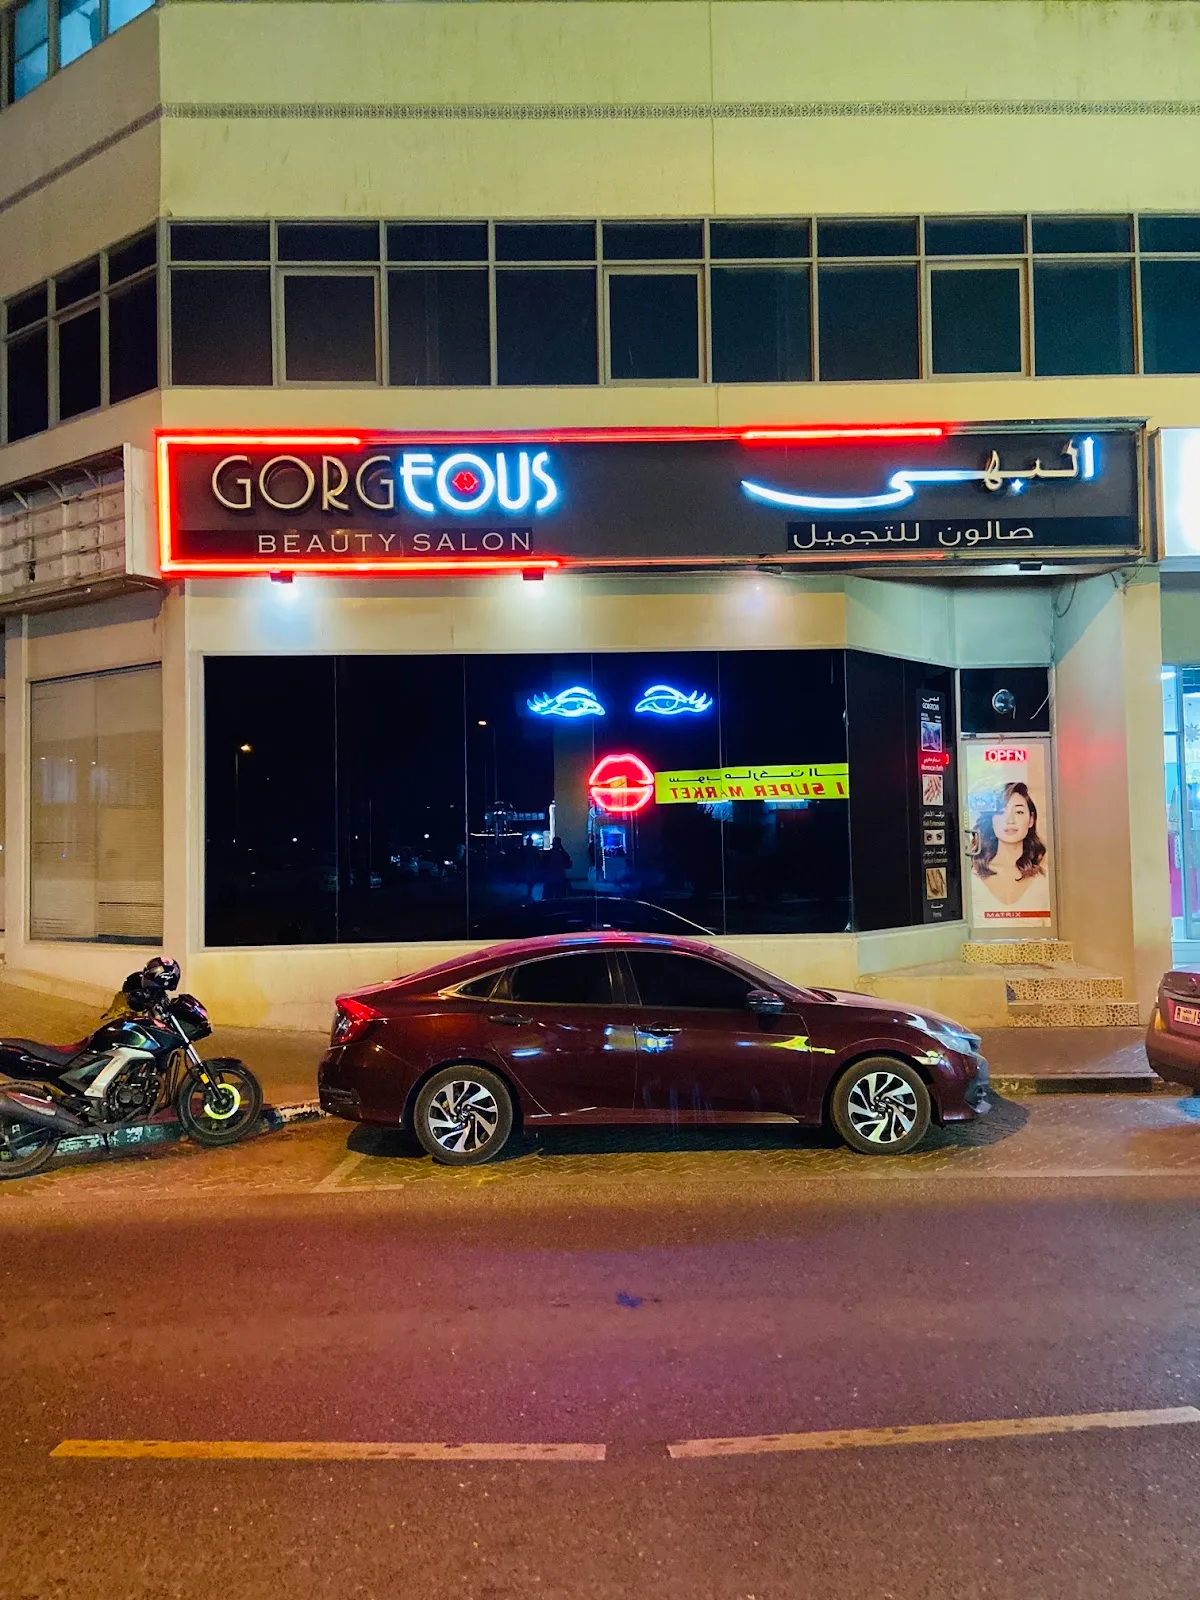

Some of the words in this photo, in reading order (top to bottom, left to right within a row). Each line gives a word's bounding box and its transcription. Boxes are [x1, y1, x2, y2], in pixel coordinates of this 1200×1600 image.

[211, 452, 558, 511] GORGEOUS
[258, 533, 396, 553] BEAUTY
[412, 532, 531, 552] SALON
[793, 522, 920, 549] للتجميل
[938, 521, 1034, 546] صالون
[988, 750, 1024, 761] OPEN
